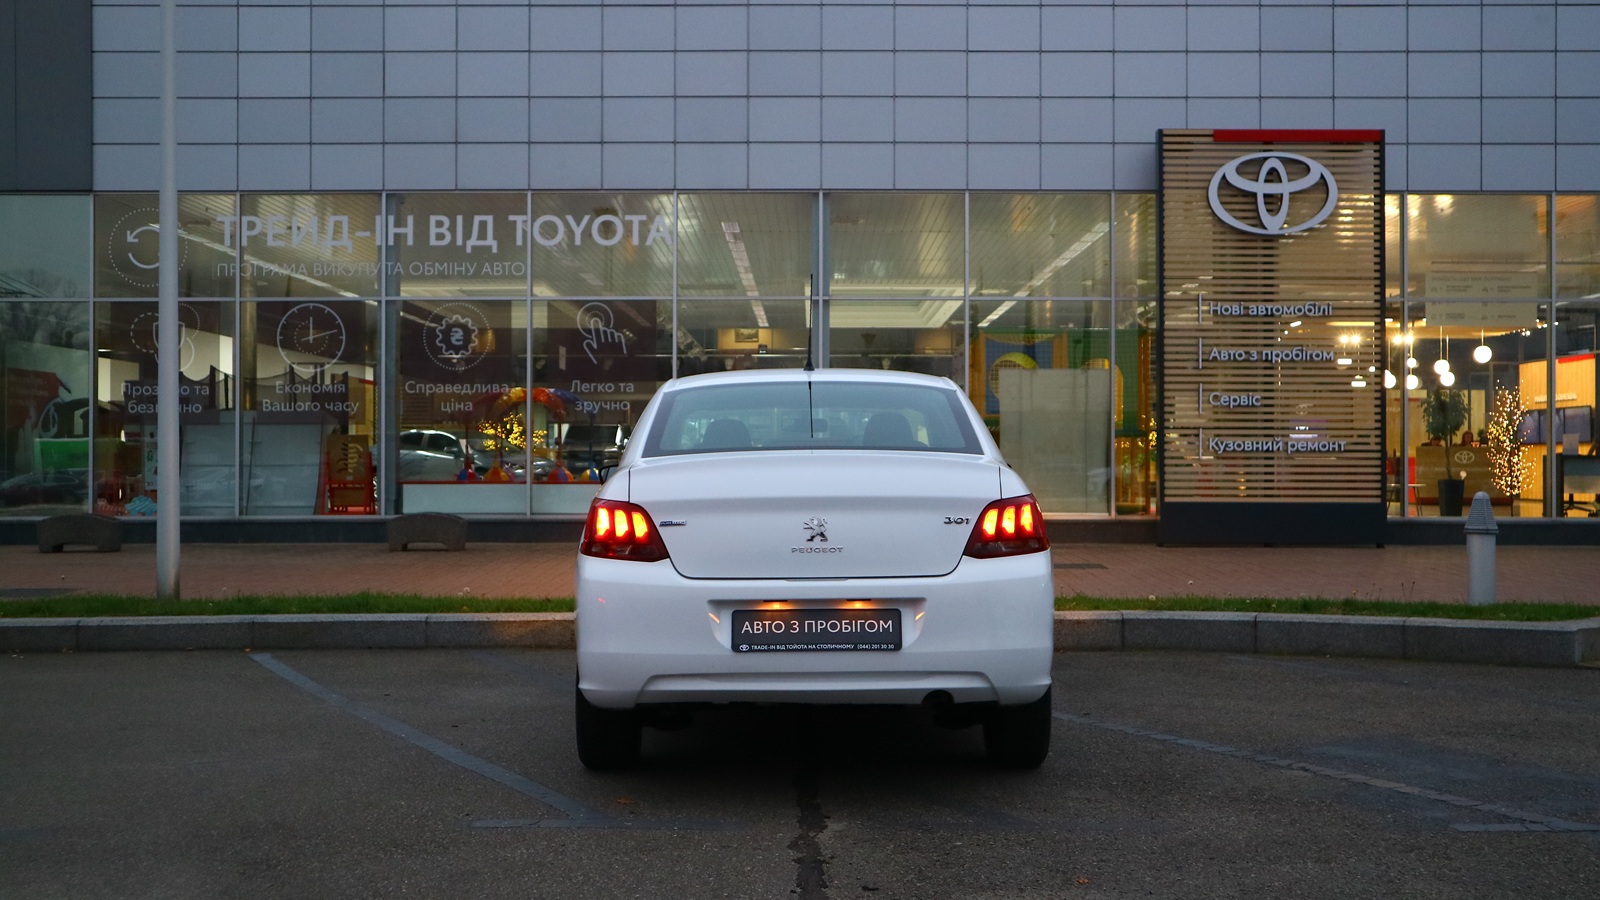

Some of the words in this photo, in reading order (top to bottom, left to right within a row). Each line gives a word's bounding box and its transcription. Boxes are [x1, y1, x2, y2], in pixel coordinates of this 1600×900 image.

[216, 208, 414, 253] ТРЕЙД-ІН
[429, 215, 498, 253] ВІД
[508, 214, 673, 246] TOYOTA
[314, 262, 380, 276] ВИКУПУ
[386, 261, 404, 275] ТА
[409, 261, 477, 276] ОБМІНУ
[481, 261, 525, 276] АВТО
[1209, 301, 1244, 316] Нові
[1248, 301, 1333, 316] автомобілі
[1209, 347, 1245, 361] Авто
[1249, 350, 1258, 361] з
[1262, 347, 1334, 364] пробігом
[121, 382, 190, 398] Прозо
[194, 385, 210, 396] та
[275, 382, 346, 394] Економія
[405, 381, 509, 396] Справедлива
[570, 380, 615, 394] Легко
[618, 382, 634, 393] та
[262, 399, 320, 412] Вашого
[325, 401, 359, 415] часу
[440, 398, 473, 413] ціна
[574, 400, 630, 414] зручно
[1209, 392, 1262, 408] Сервіс
[1209, 437, 1283, 454] Кузовний
[1287, 440, 1346, 454] ремонт
[944, 515, 971, 525] 301
[791, 545, 844, 554] PEUGEOT
[741, 620, 785, 634] АВТО
[790, 620, 799, 634] З
[804, 619, 893, 633] ПРОБІГОМ
